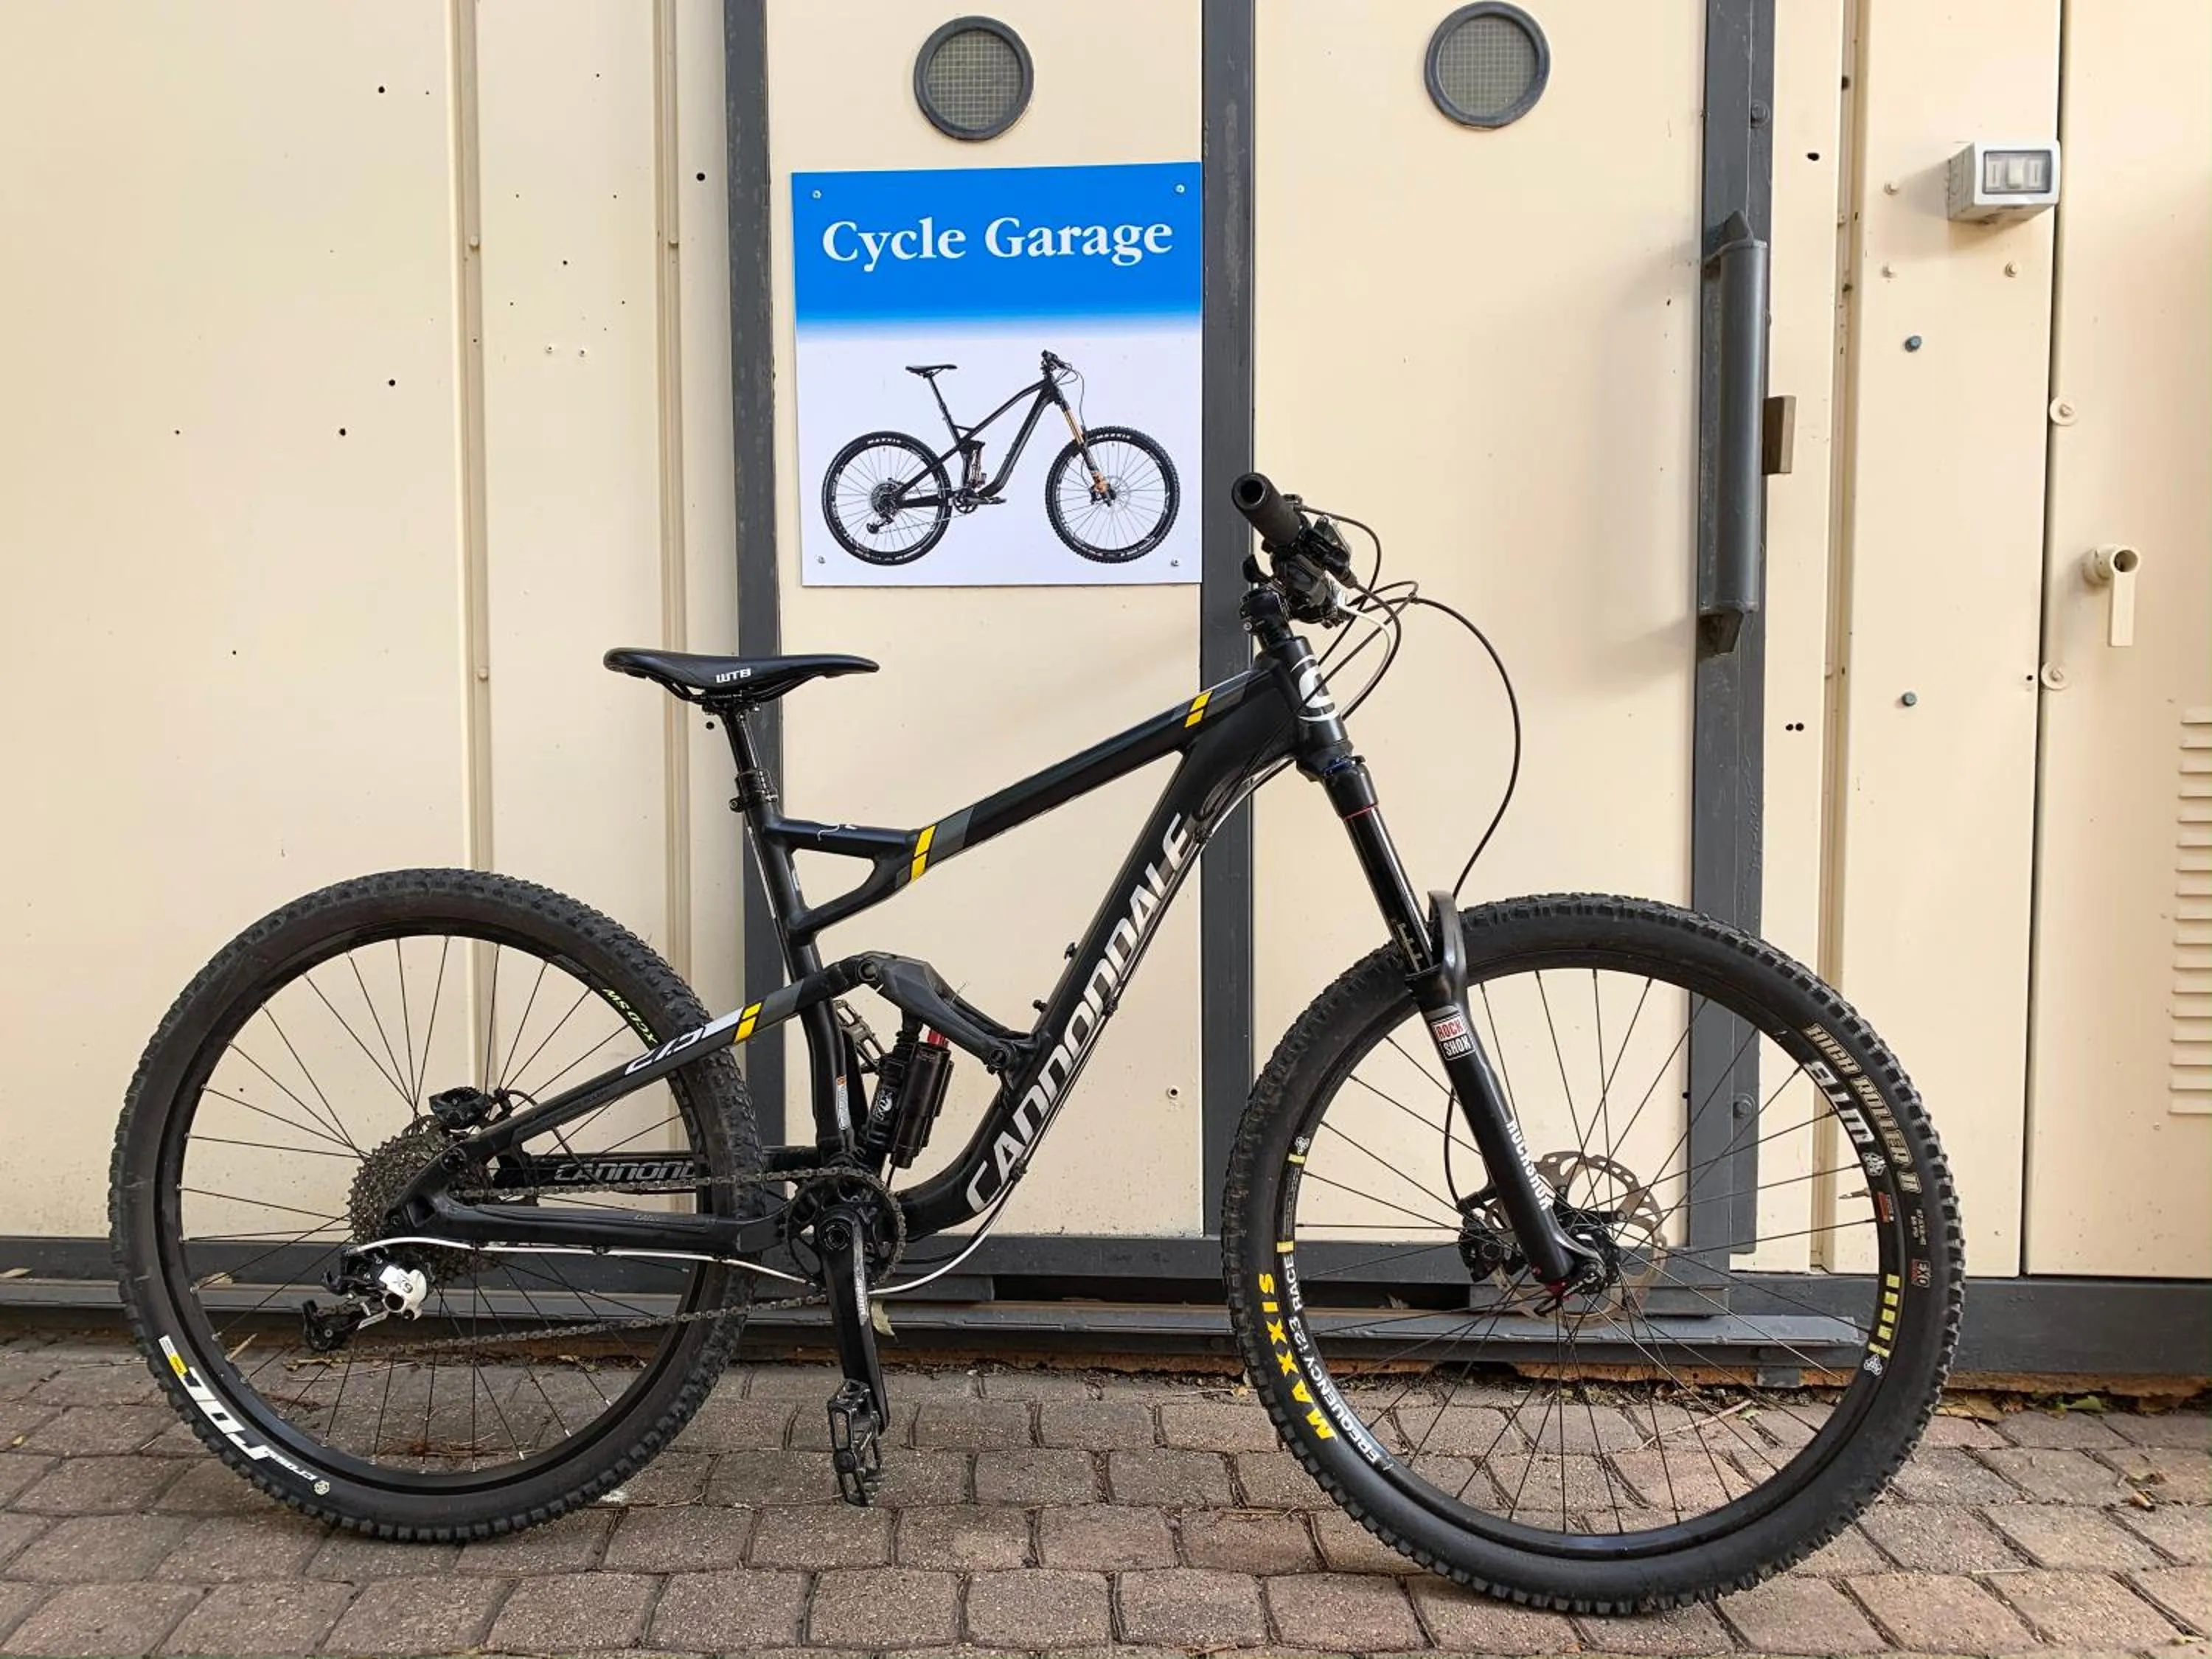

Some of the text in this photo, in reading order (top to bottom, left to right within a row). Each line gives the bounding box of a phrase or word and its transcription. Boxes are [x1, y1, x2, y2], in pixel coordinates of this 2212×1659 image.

[821, 216, 1173, 272] Cycle Garage
[715, 668, 751, 684] WTB
[1436, 1015, 1465, 1040] ROCK
[1443, 1035, 1472, 1057] SHOX
[1803, 1060, 1876, 1144] WTB
[1806, 1022, 1863, 1074] HIGH
[1848, 1074, 1913, 1169] ROLLER
[1284, 1254, 1304, 1311] RACE
[1259, 1273, 1336, 1440] MAXXIS
[1301, 1357, 1381, 1464] FREQUENCY
